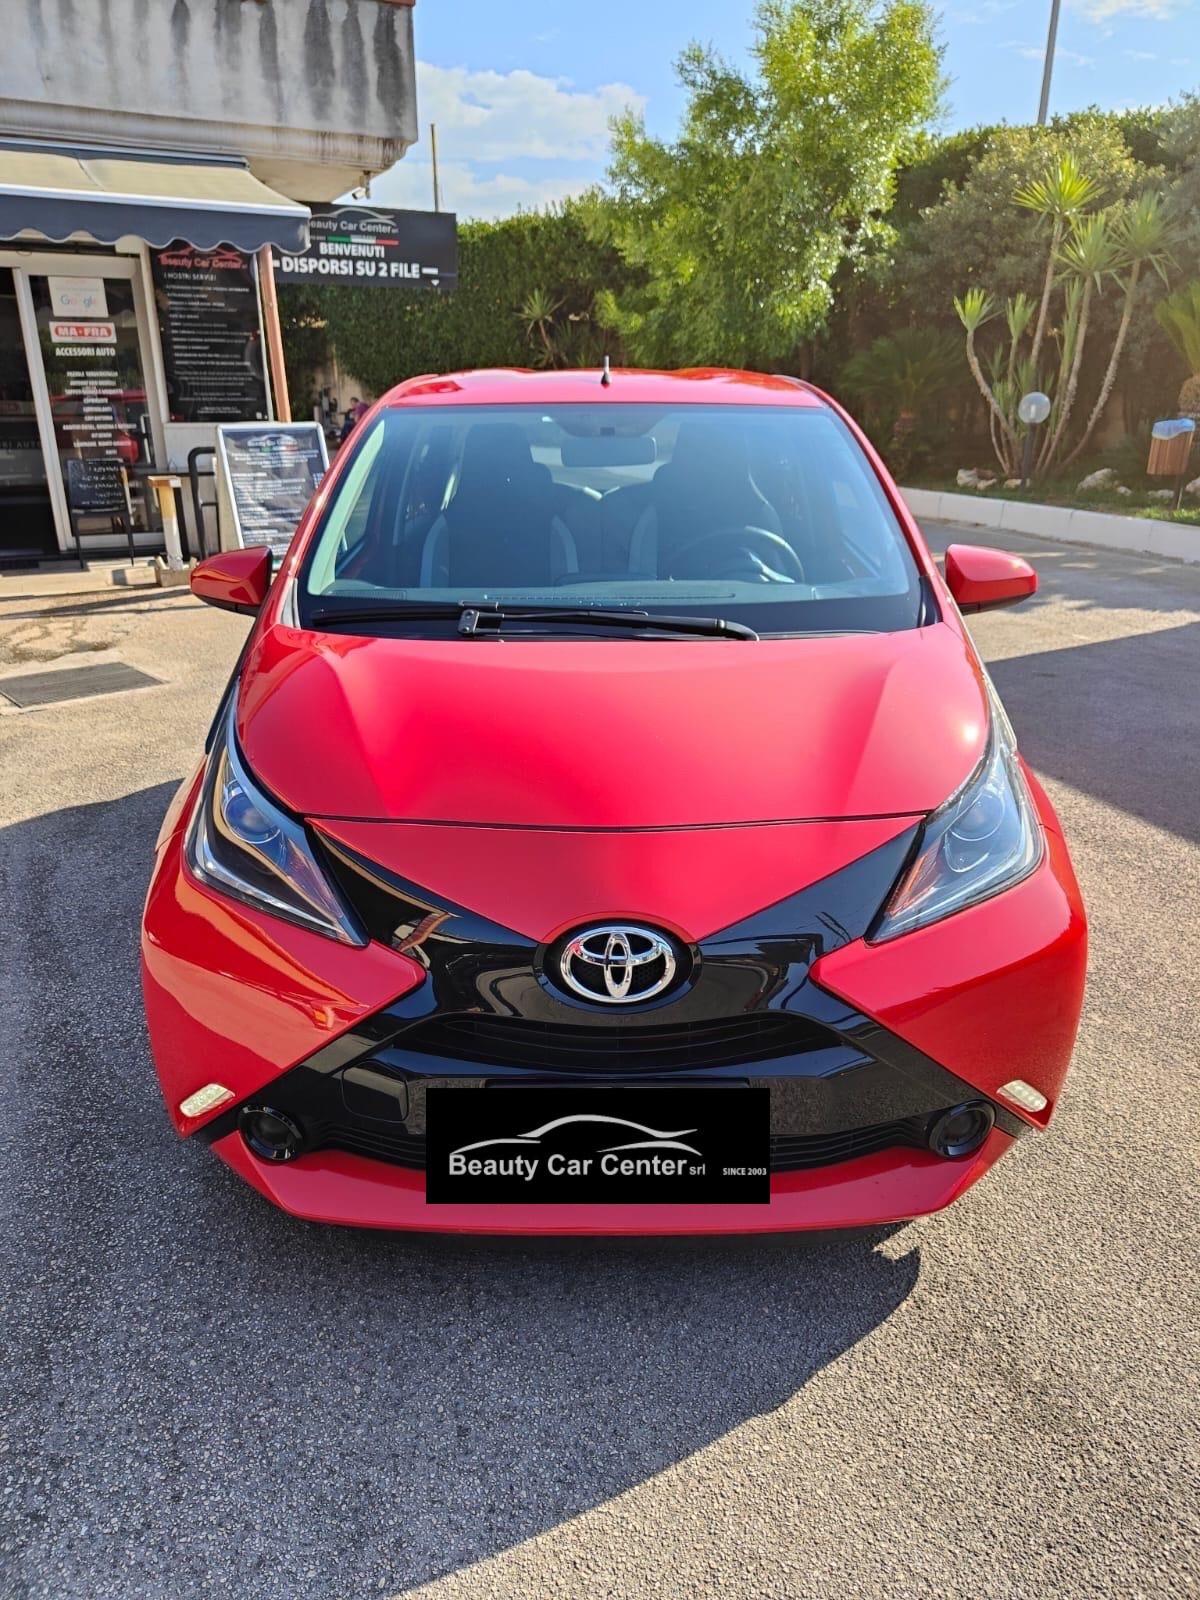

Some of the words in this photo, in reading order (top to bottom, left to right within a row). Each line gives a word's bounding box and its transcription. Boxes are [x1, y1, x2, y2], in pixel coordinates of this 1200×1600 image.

[309, 219, 339, 232] eauty
[340, 220, 358, 231] Car
[360, 221, 392, 234] Center
[319, 242, 385, 258] BENVENUTI
[281, 256, 353, 275] DISPORSI
[355, 260, 376, 277] SU
[378, 261, 388, 277] 2
[390, 262, 421, 279] FILE
[55, 346, 95, 357] ACCESSORI
[95, 347, 116, 357] AUTO
